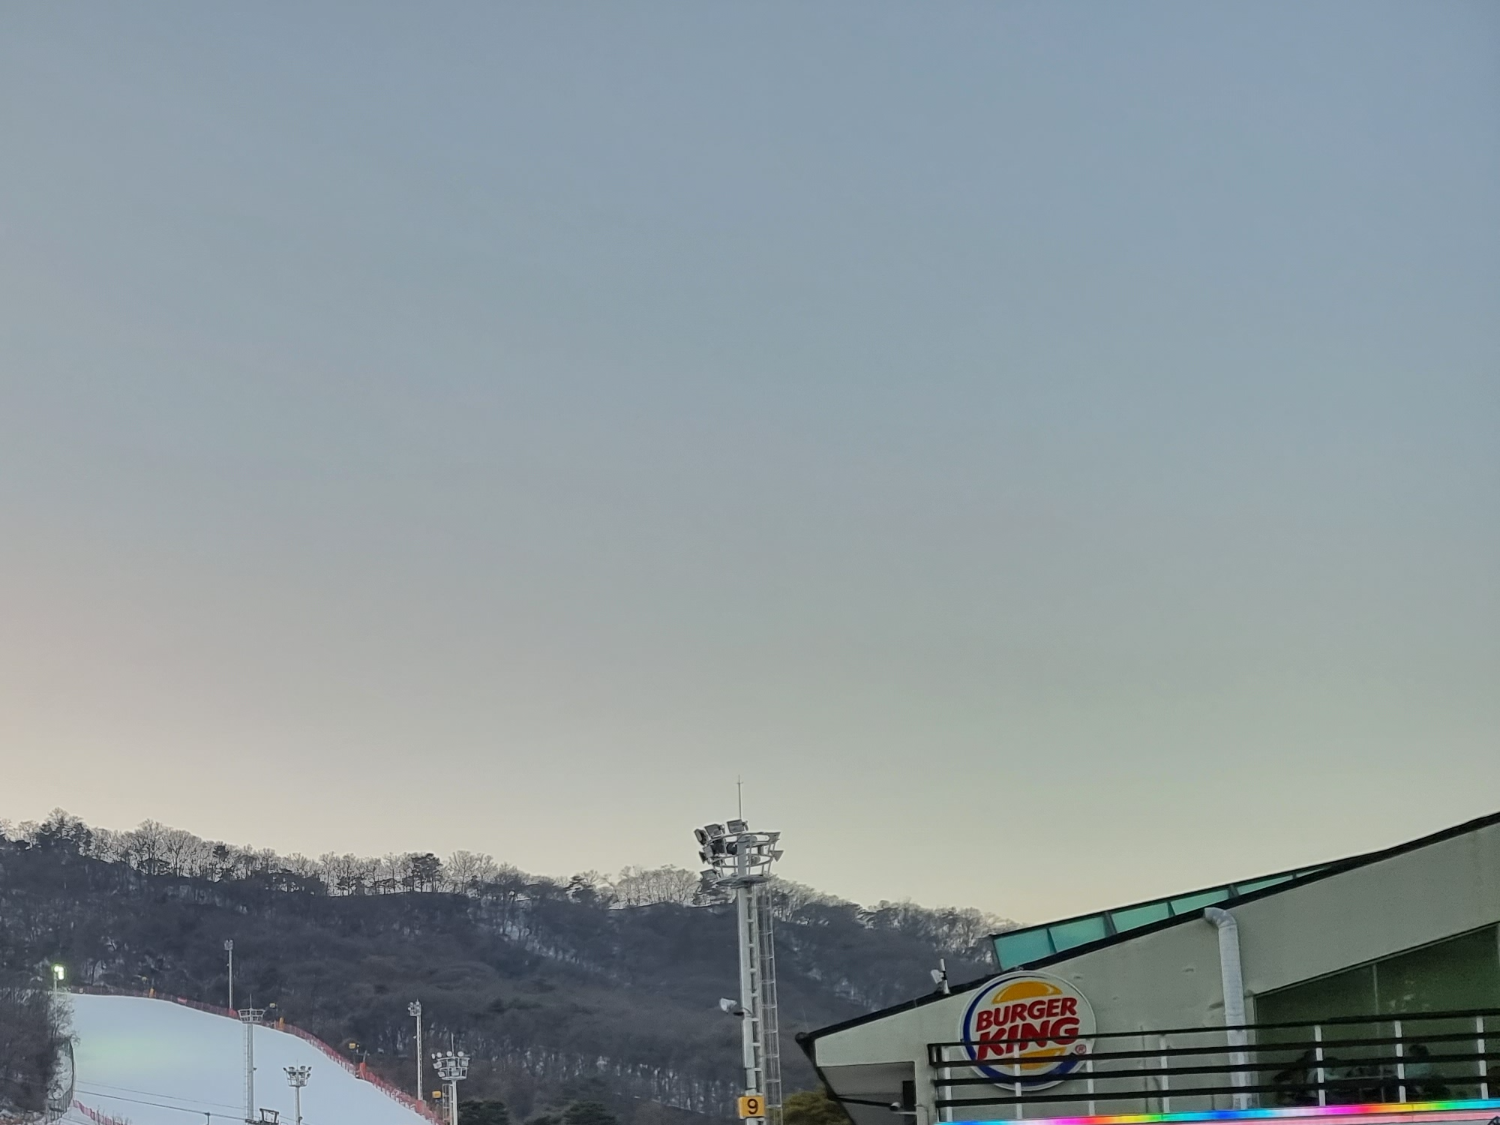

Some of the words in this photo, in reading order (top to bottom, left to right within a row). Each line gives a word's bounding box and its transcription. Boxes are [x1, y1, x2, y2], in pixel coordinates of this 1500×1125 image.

[975, 996, 1078, 1033] BURGER
[976, 1016, 1081, 1061] KING
[746, 1098, 759, 1115] 9
